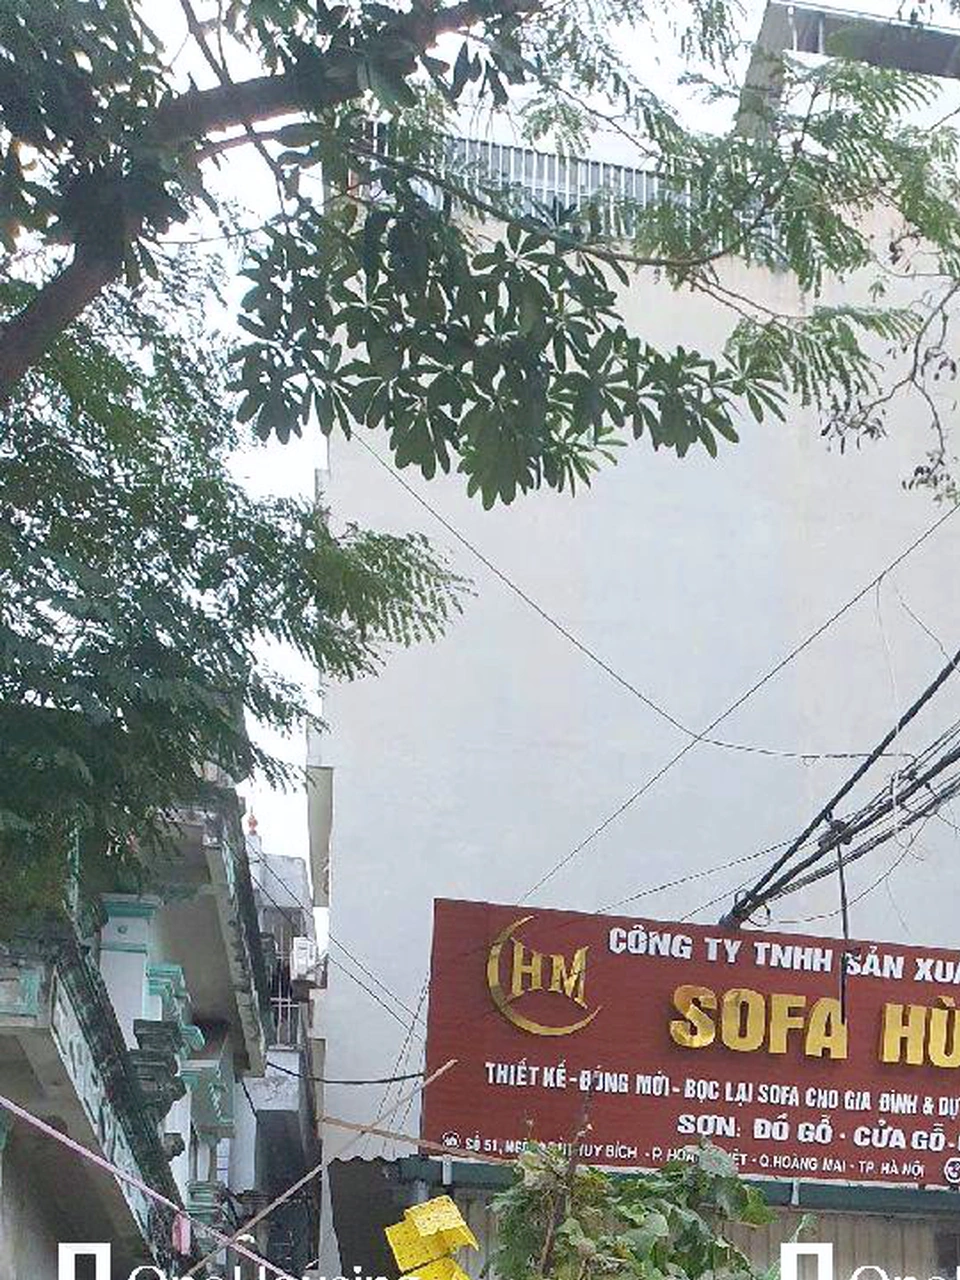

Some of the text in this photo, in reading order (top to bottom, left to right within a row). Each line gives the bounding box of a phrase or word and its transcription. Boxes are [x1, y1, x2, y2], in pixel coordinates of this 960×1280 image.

[509, 937, 590, 1009] HM
[609, 924, 693, 959] CÔNG
[704, 937, 742, 963] TY
[754, 942, 832, 972] TNHH
[846, 946, 904, 979] SẢN
[669, 984, 849, 1060] SOFA
[486, 1058, 539, 1087] THIẾT
[543, 1060, 567, 1088] KẾ
[636, 1070, 669, 1097] MỚI
[684, 1079, 719, 1103] BỌC
[726, 1082, 753, 1107] LẠI
[758, 1084, 800, 1107] SOFA
[805, 1088, 838, 1111] CHO
[844, 1090, 872, 1111] GIA
[879, 1090, 918, 1115] ĐÌNH
[922, 1096, 934, 1115] &
[606, 1140, 638, 1159] BÍCH
[822, 1158, 847, 1173] MAI
[881, 1159, 899, 1175] HÀ
[902, 1160, 926, 1180] NỘI
[677, 1114, 741, 1138] SƠN:
[797, 1114, 833, 1144] GỖ
[853, 1119, 907, 1149] CỬA
[911, 1123, 946, 1151] GỖ
